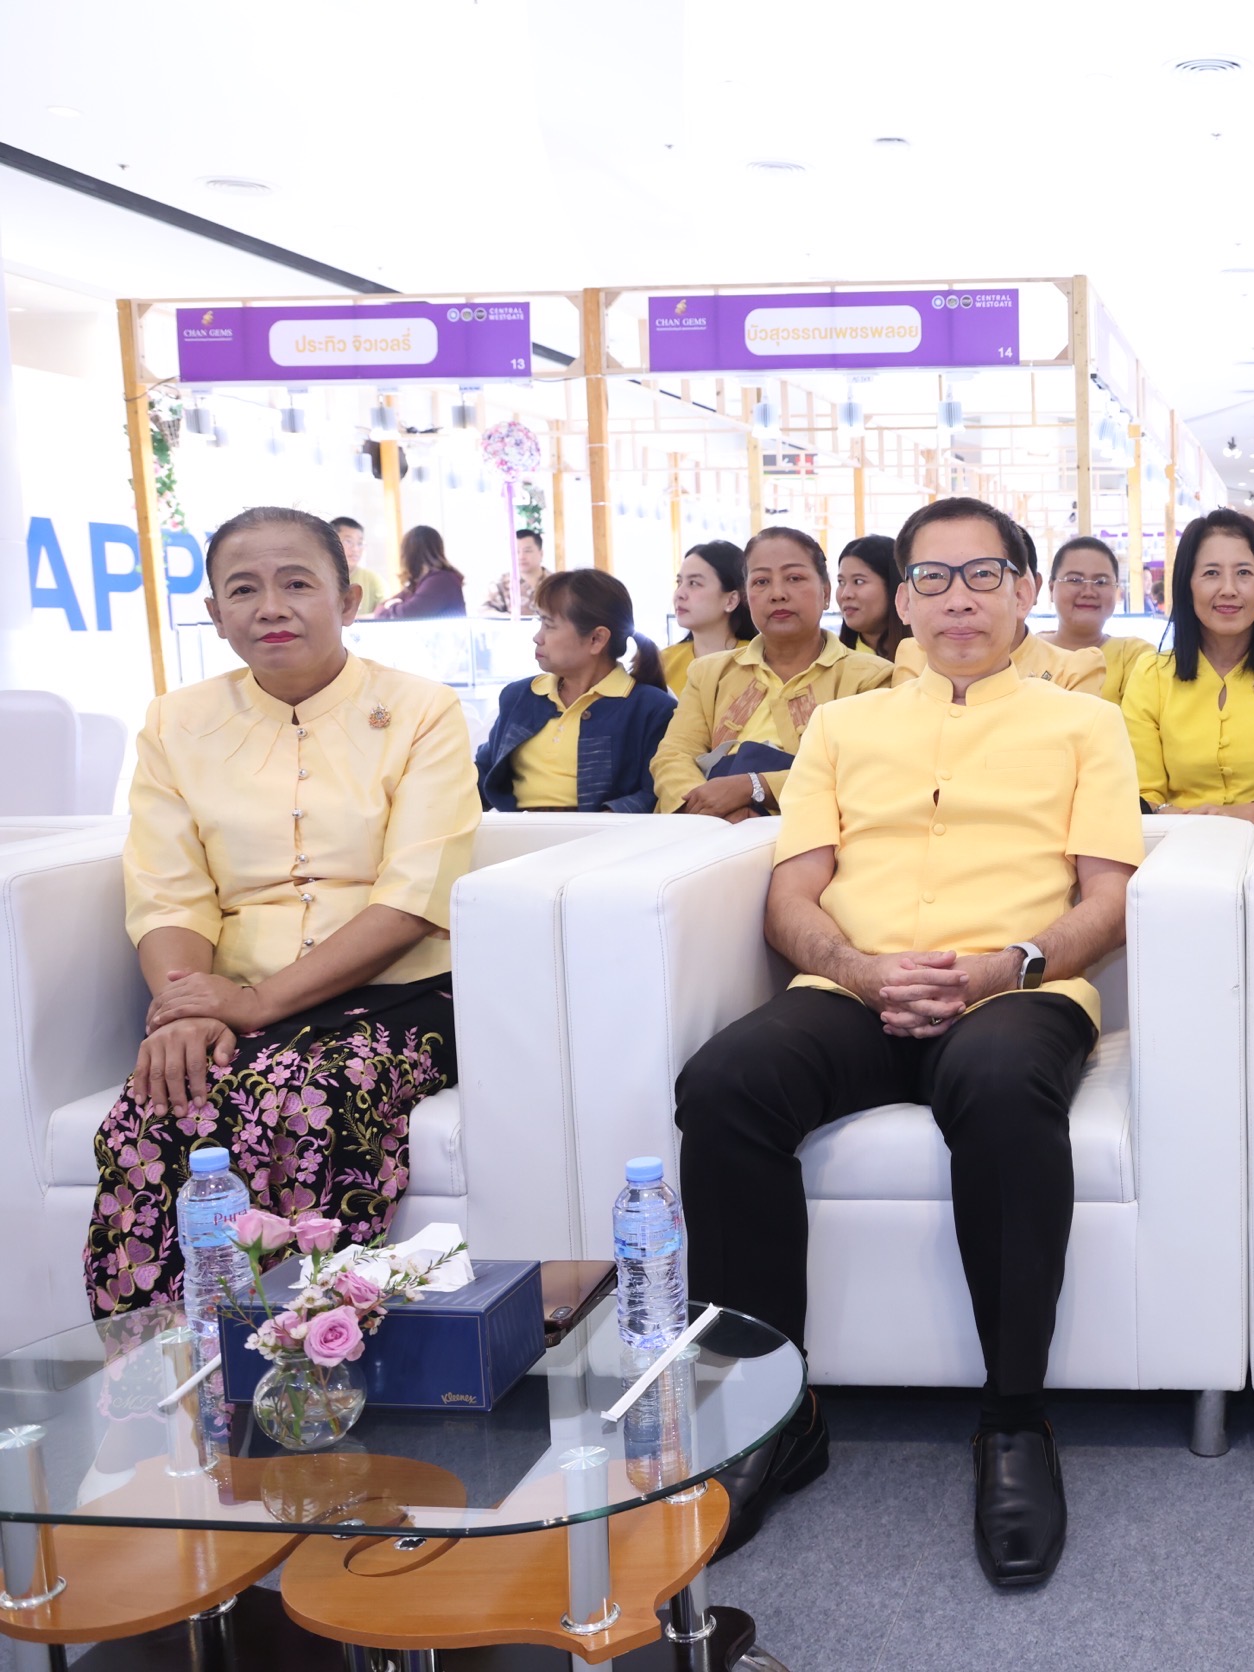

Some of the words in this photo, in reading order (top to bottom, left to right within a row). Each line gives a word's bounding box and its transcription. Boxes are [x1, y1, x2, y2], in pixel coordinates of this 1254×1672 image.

[655, 318, 681, 327] CHAN
[682, 317, 707, 326] GEMS
[183, 329, 207, 337] CHAN
[209, 329, 233, 337] GEMS
[998, 347, 1013, 358] 14
[510, 358, 525, 370] 13
[441, 1391, 478, 1405] Kleenex
